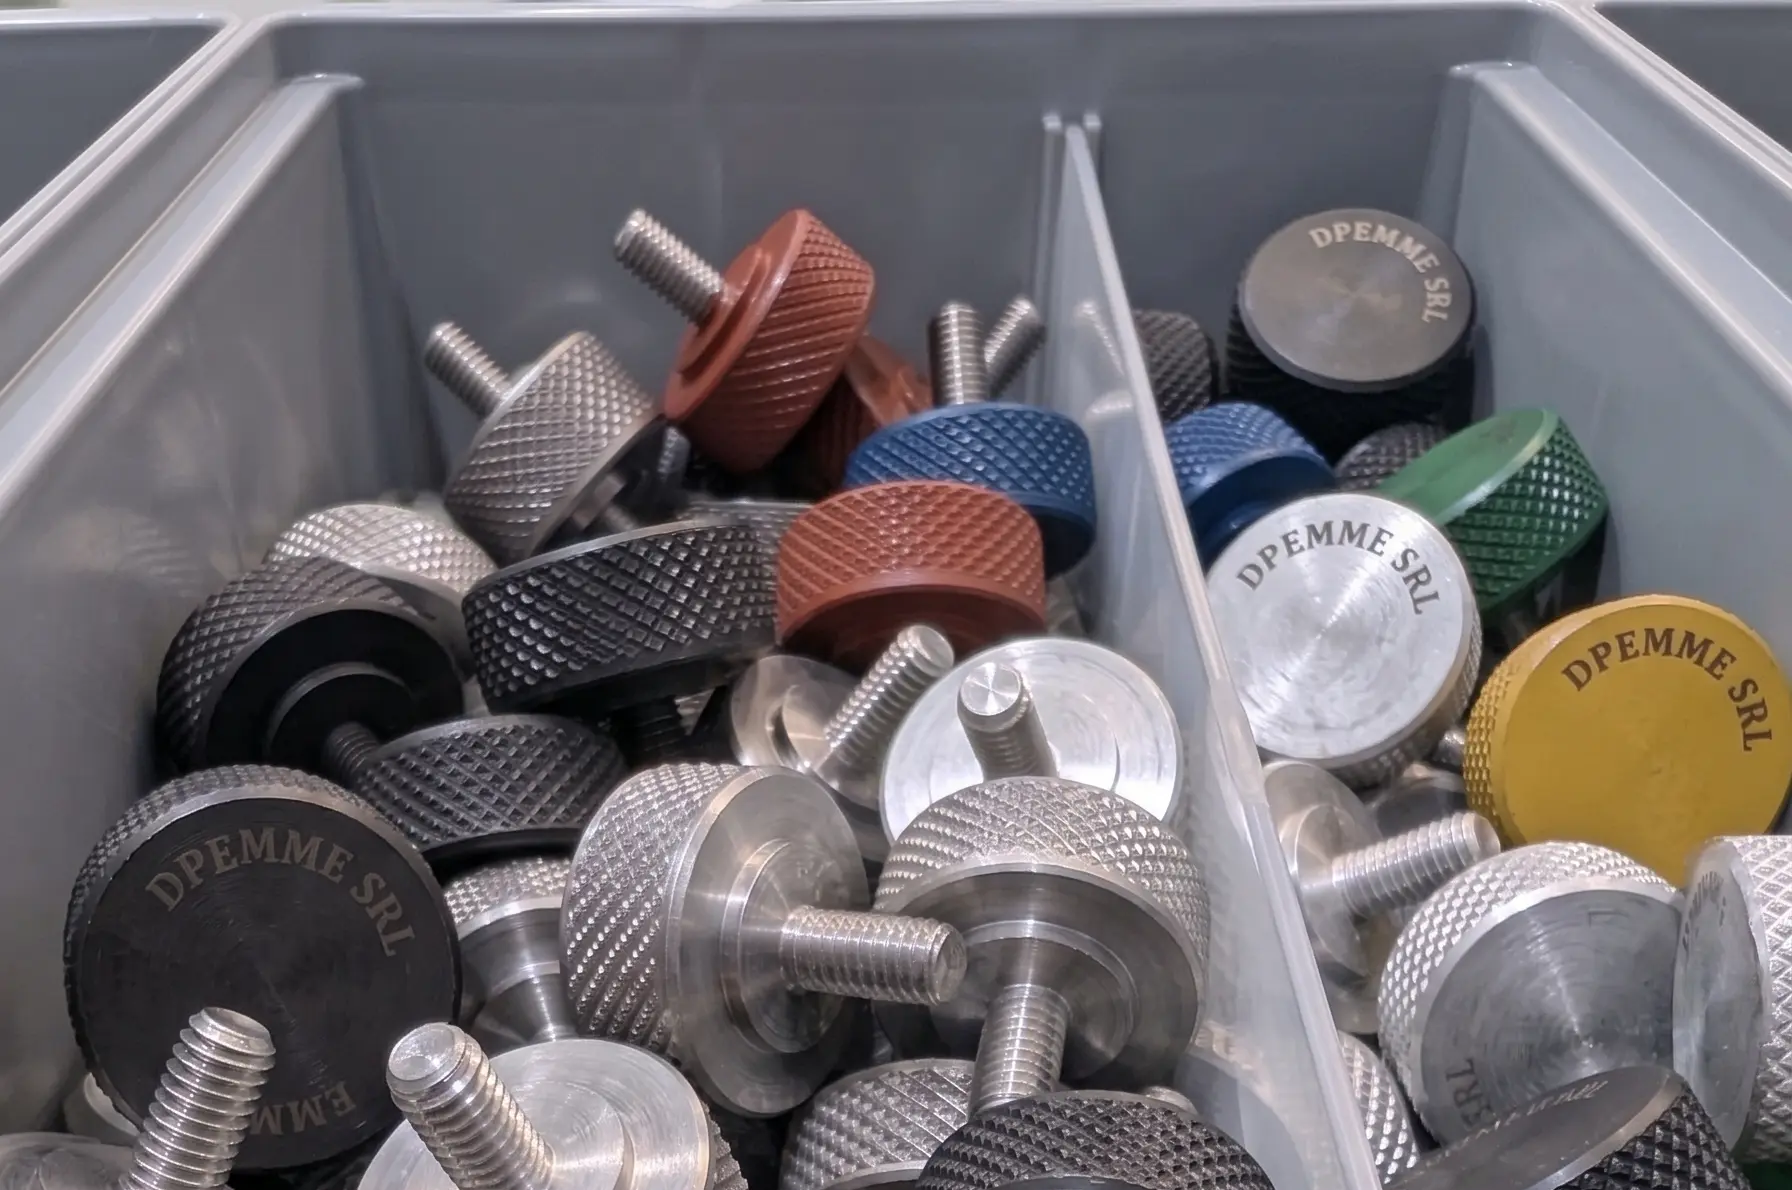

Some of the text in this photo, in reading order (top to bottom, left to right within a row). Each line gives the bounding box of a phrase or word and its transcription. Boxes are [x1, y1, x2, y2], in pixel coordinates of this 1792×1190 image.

[1308, 221, 1453, 323] DPEMME SRL
[1236, 519, 1440, 615] DPEMME SRL
[1561, 627, 1773, 752] DPEMME SRL
[145, 826, 416, 958] DPEMME SRL
